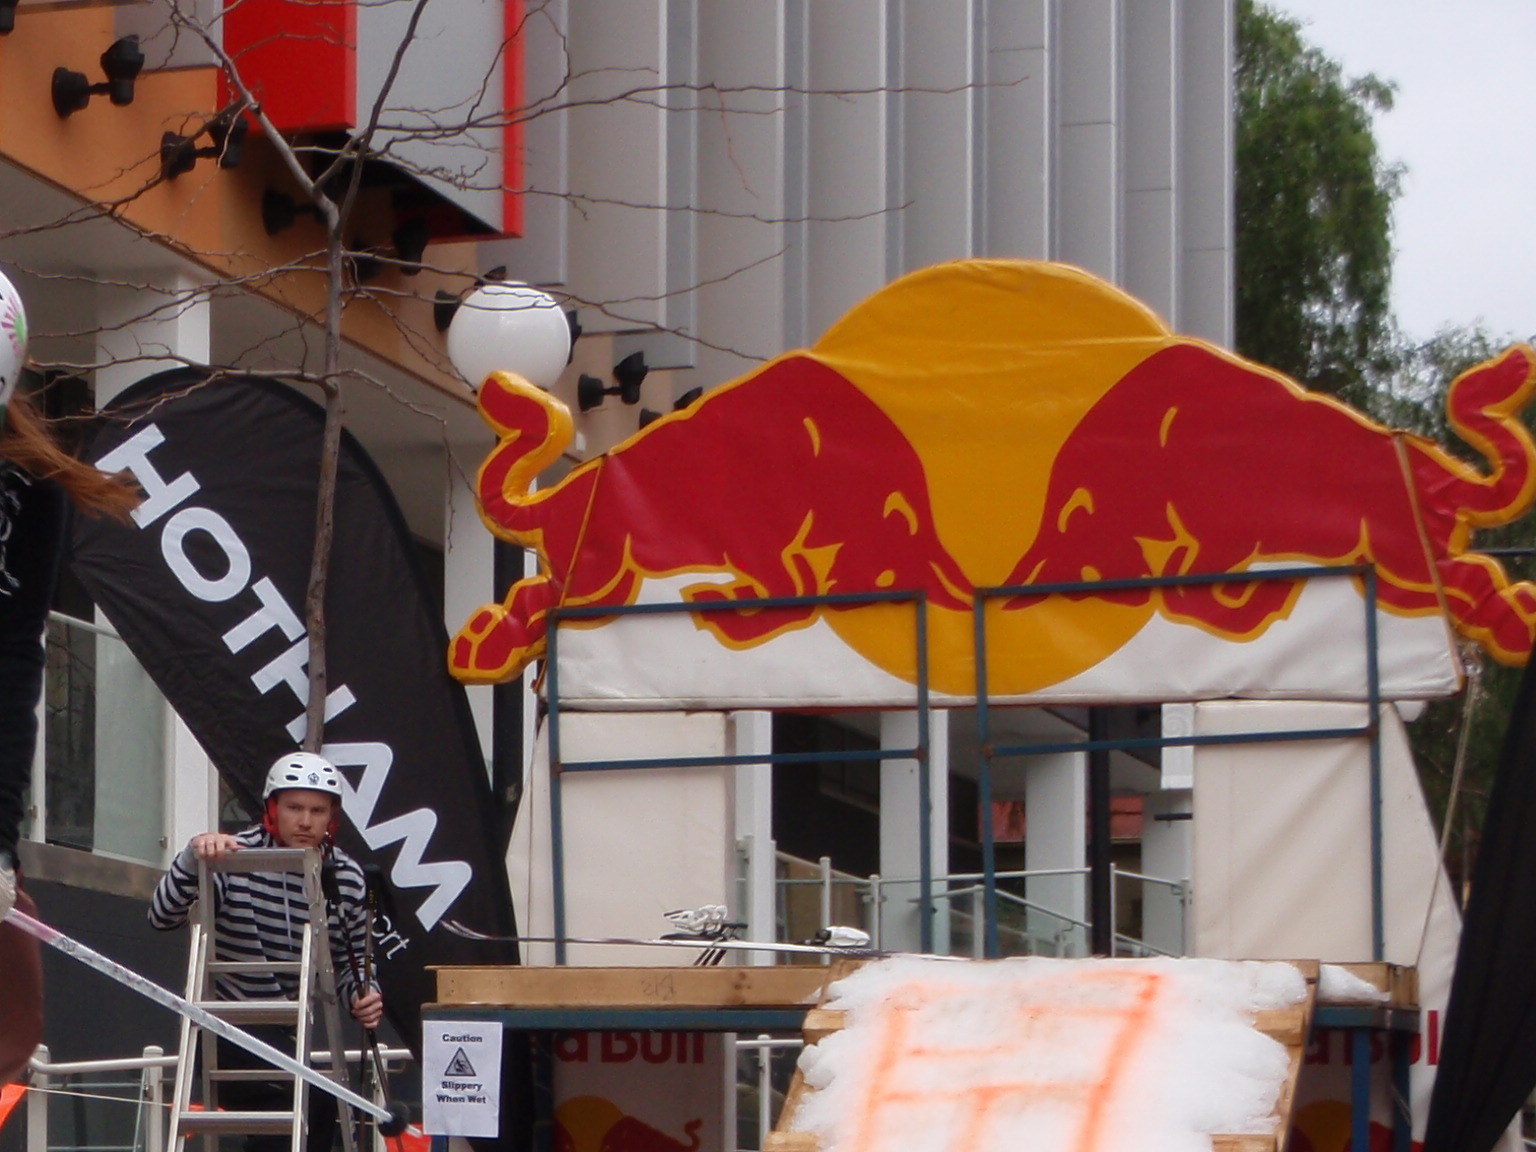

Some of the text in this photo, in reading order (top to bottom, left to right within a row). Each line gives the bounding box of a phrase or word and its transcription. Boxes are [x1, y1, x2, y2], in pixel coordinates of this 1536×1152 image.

[94, 423, 473, 933] HOTHAM
[442, 1033, 483, 1043] Caution
[441, 1080, 483, 1092] Slippery
[435, 1093, 487, 1104] When Wet
